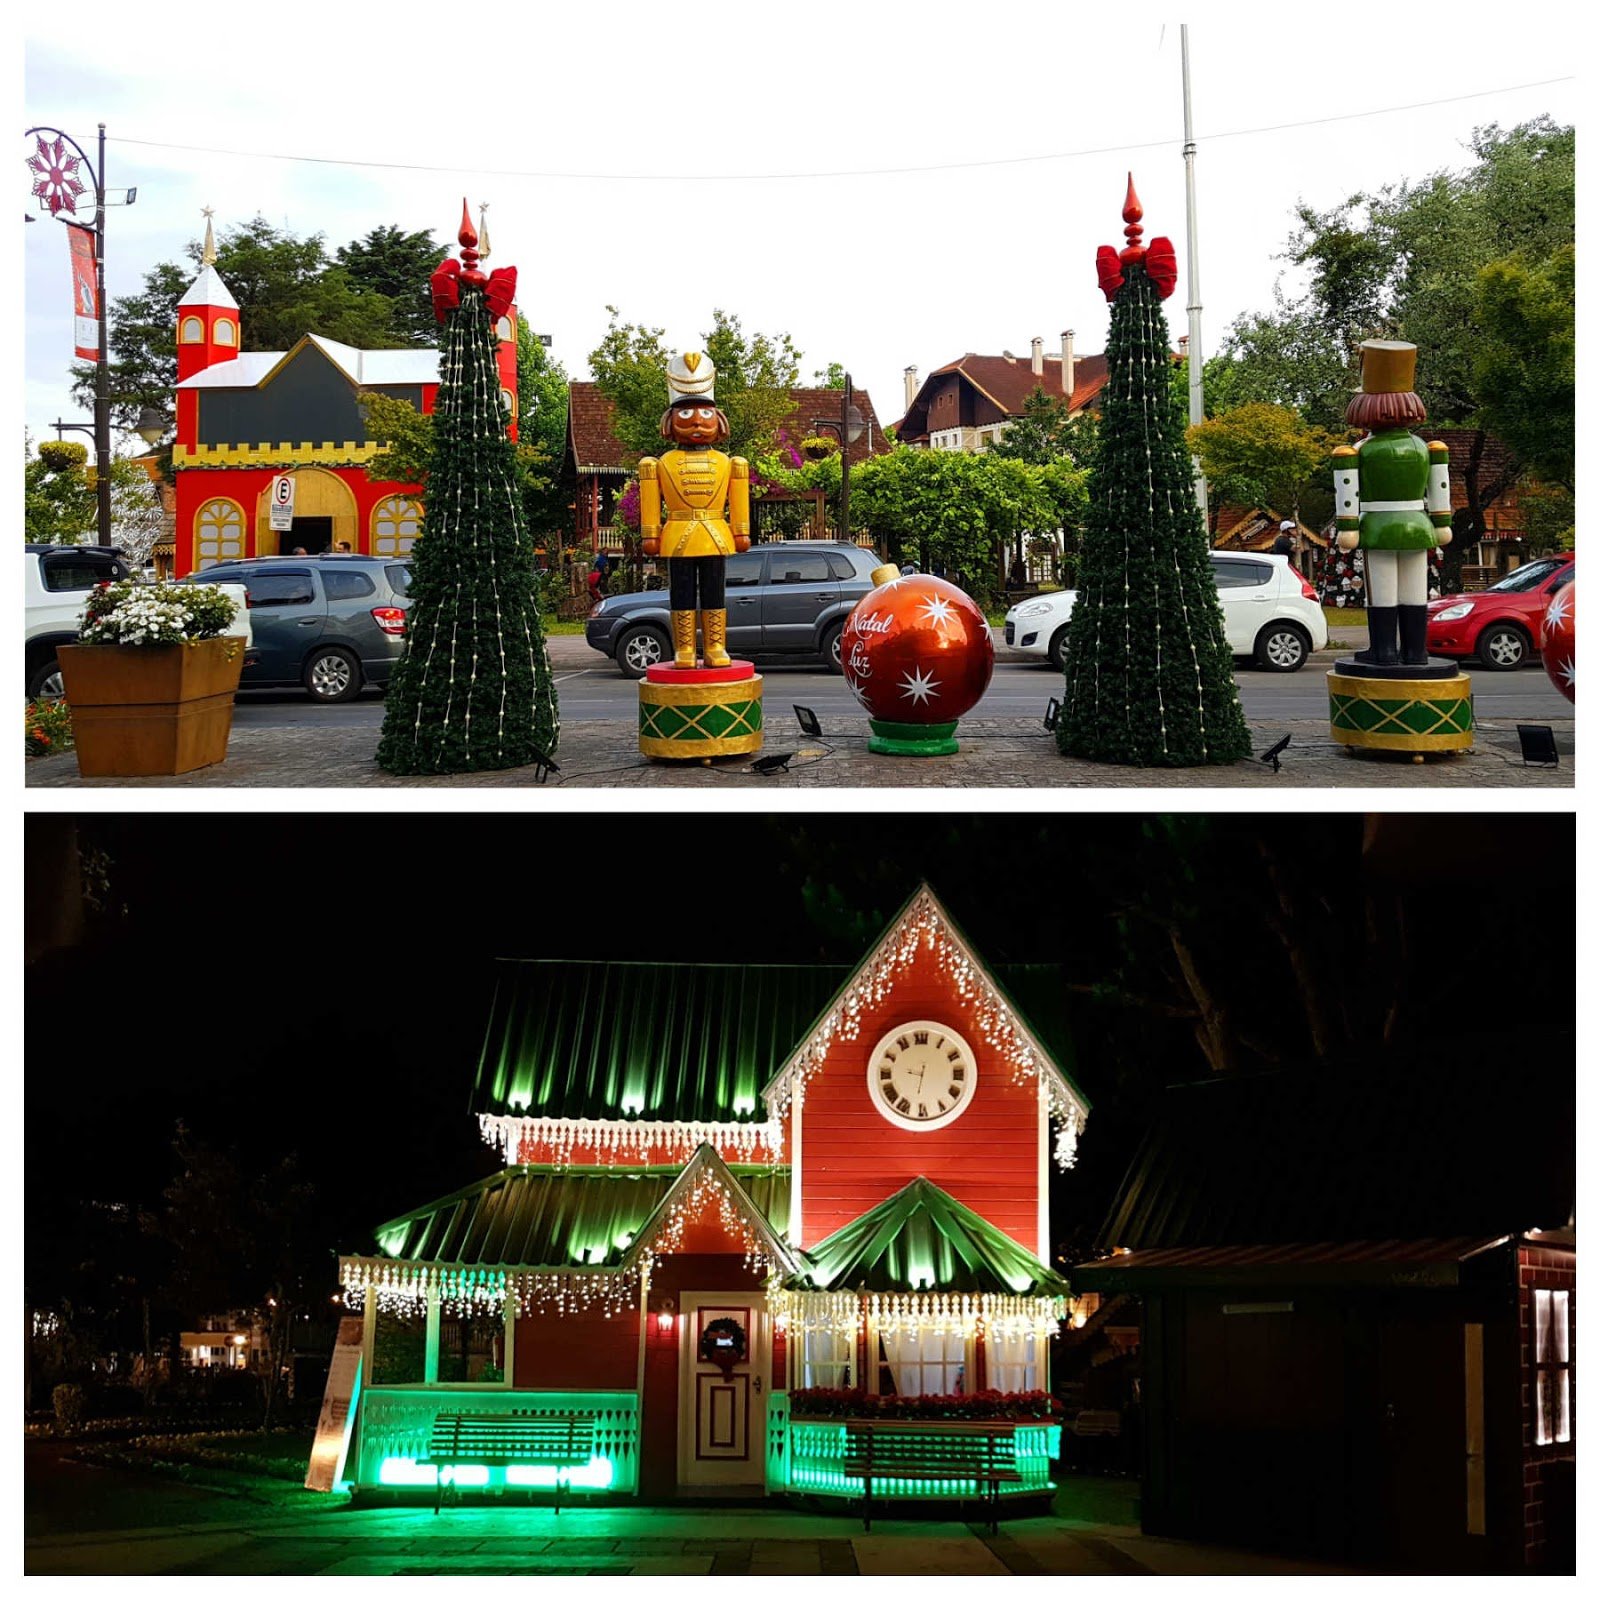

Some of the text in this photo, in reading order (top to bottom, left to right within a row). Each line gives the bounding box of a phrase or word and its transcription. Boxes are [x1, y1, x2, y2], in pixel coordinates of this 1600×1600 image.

[280, 482, 288, 499] E
[843, 611, 894, 640] Natal
[848, 640, 873, 678] Luz
